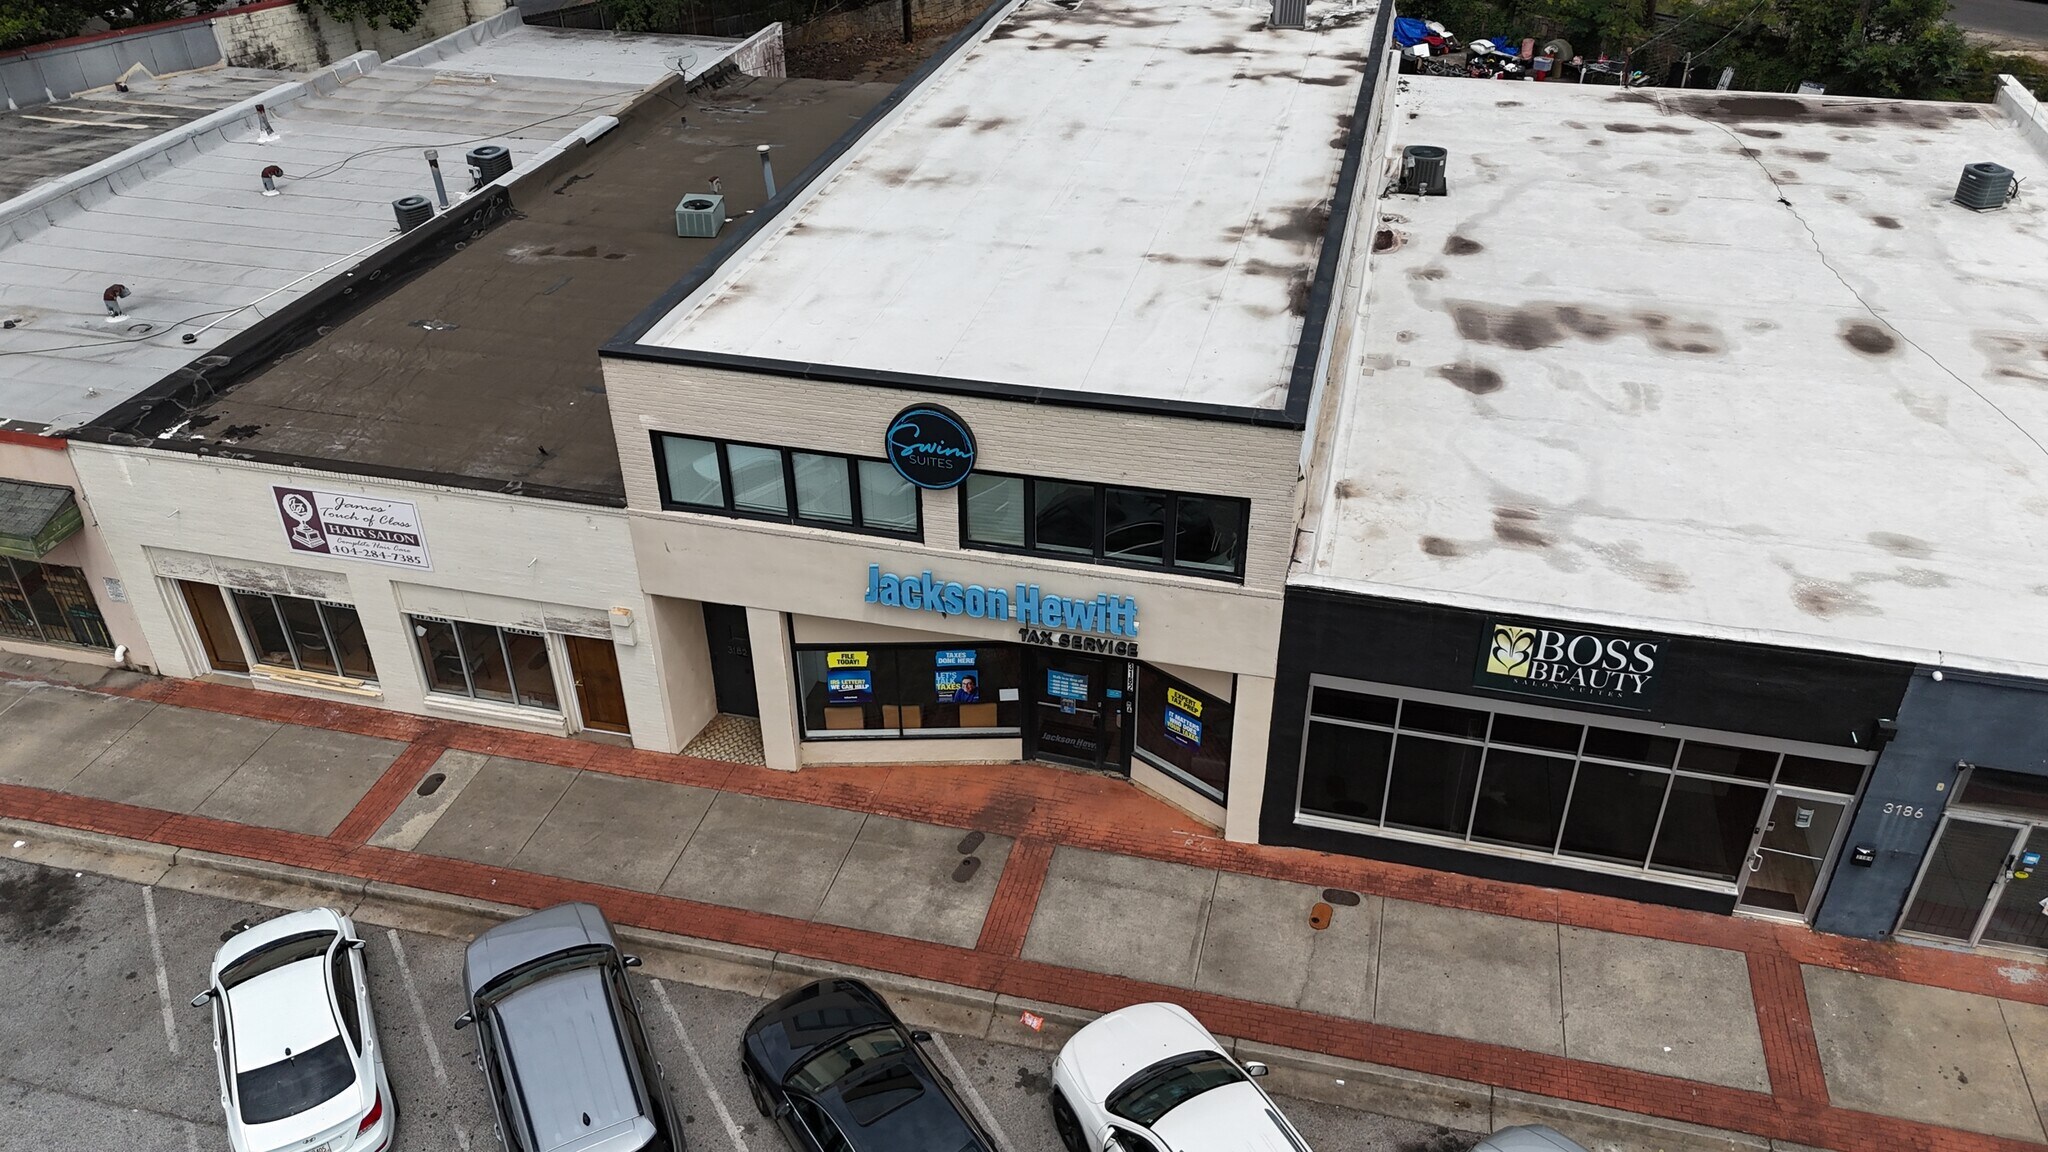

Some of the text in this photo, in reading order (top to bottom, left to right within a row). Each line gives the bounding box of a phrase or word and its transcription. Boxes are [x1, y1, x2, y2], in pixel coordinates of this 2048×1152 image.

[888, 423, 974, 458] Swim
[909, 454, 953, 469] SUITES
[320, 507, 412, 528] Touch of Class
[329, 524, 415, 544] HAIR SALON
[337, 538, 370, 547] Complete
[332, 544, 421, 564] 404-284-7385
[865, 563, 1138, 637] Jackson Hewitt
[1019, 628, 1138, 657] TAX SERVICE
[1534, 630, 1658, 673] BOSS
[1530, 661, 1652, 694] BEAUTY
[1514, 678, 1624, 698] SALON SUITES
[1171, 696, 1198, 713] TAX PREP
[1175, 692, 1196, 706] EXPERT
[1168, 712, 1199, 731] IT MATTERS
[1042, 732, 1076, 744] Jackson
[1883, 803, 1923, 818] 3186
